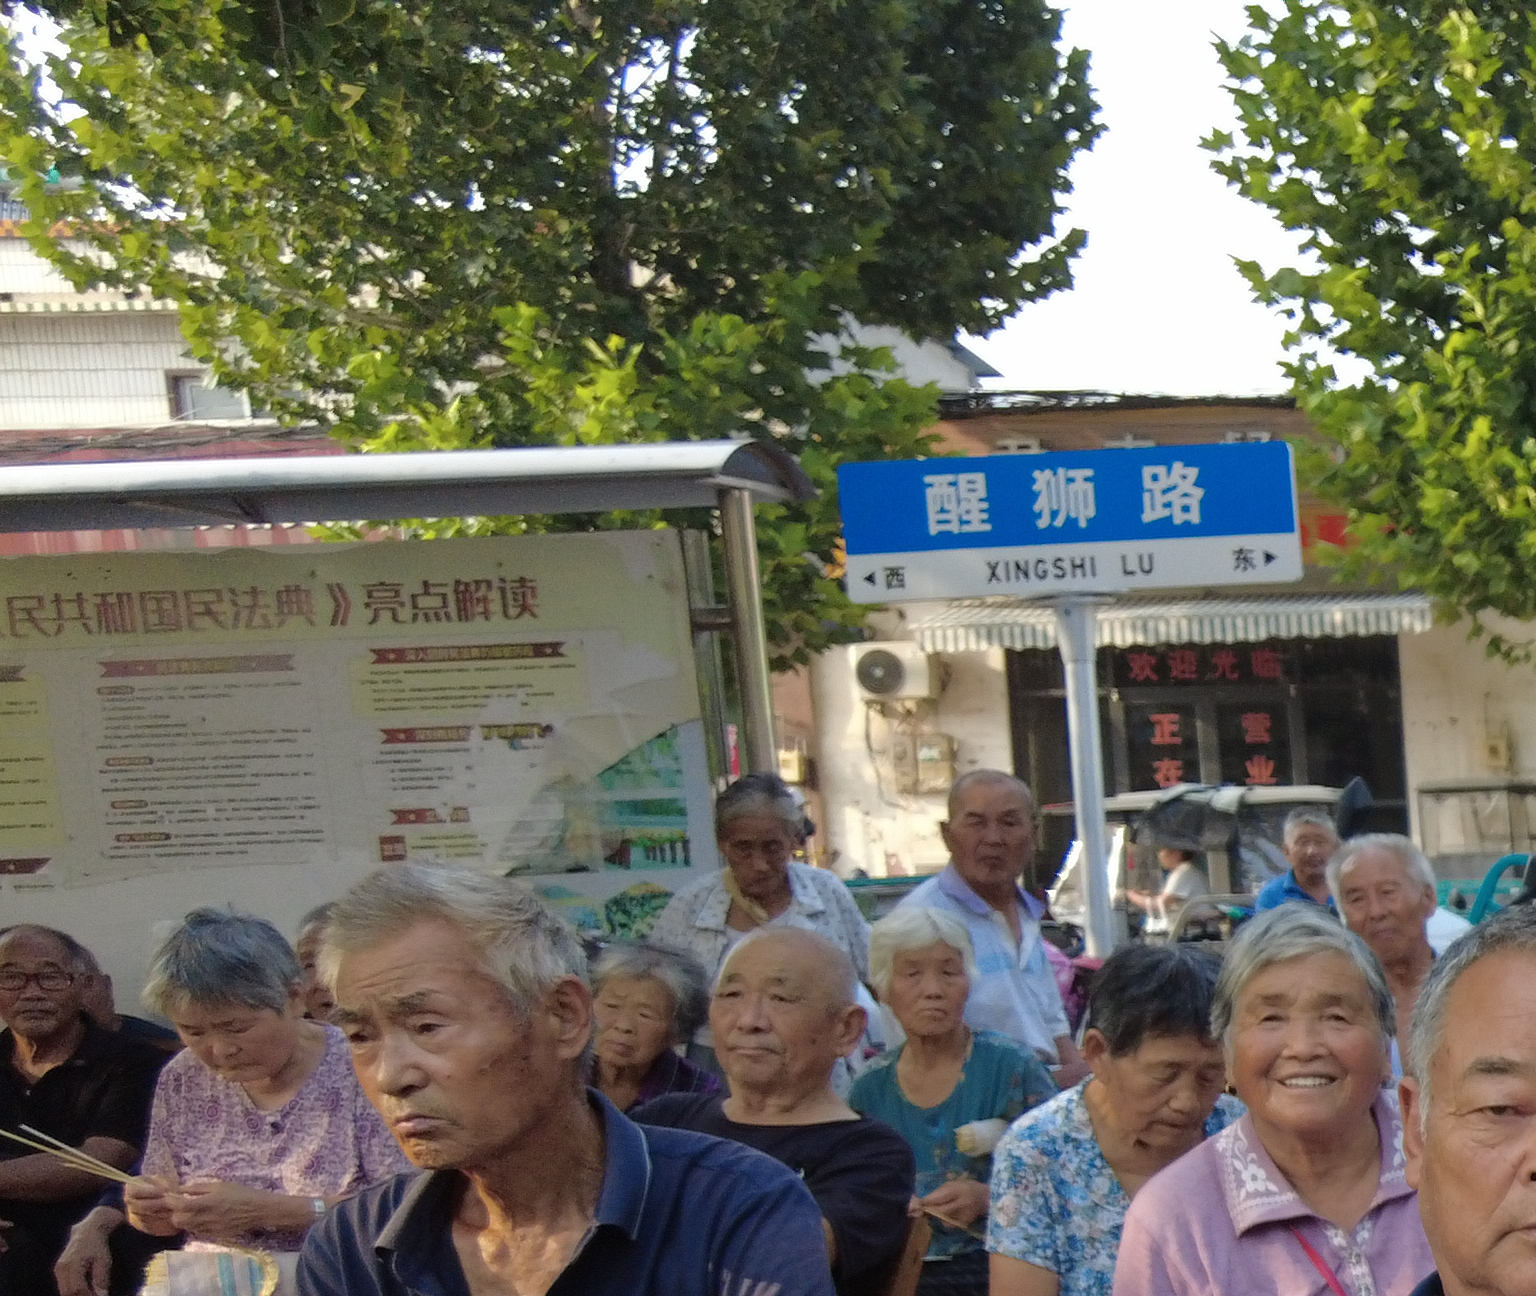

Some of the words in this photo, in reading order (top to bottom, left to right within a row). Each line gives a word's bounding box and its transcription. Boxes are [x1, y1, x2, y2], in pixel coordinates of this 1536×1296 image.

[922, 460, 1205, 537] 醒狮路
[884, 566, 906, 590] 西
[986, 554, 1098, 585] XINGSHI
[1121, 553, 1155, 576] LU
[1233, 547, 1256, 572] 东
[1127, 650, 1283, 682] 欢迎光临
